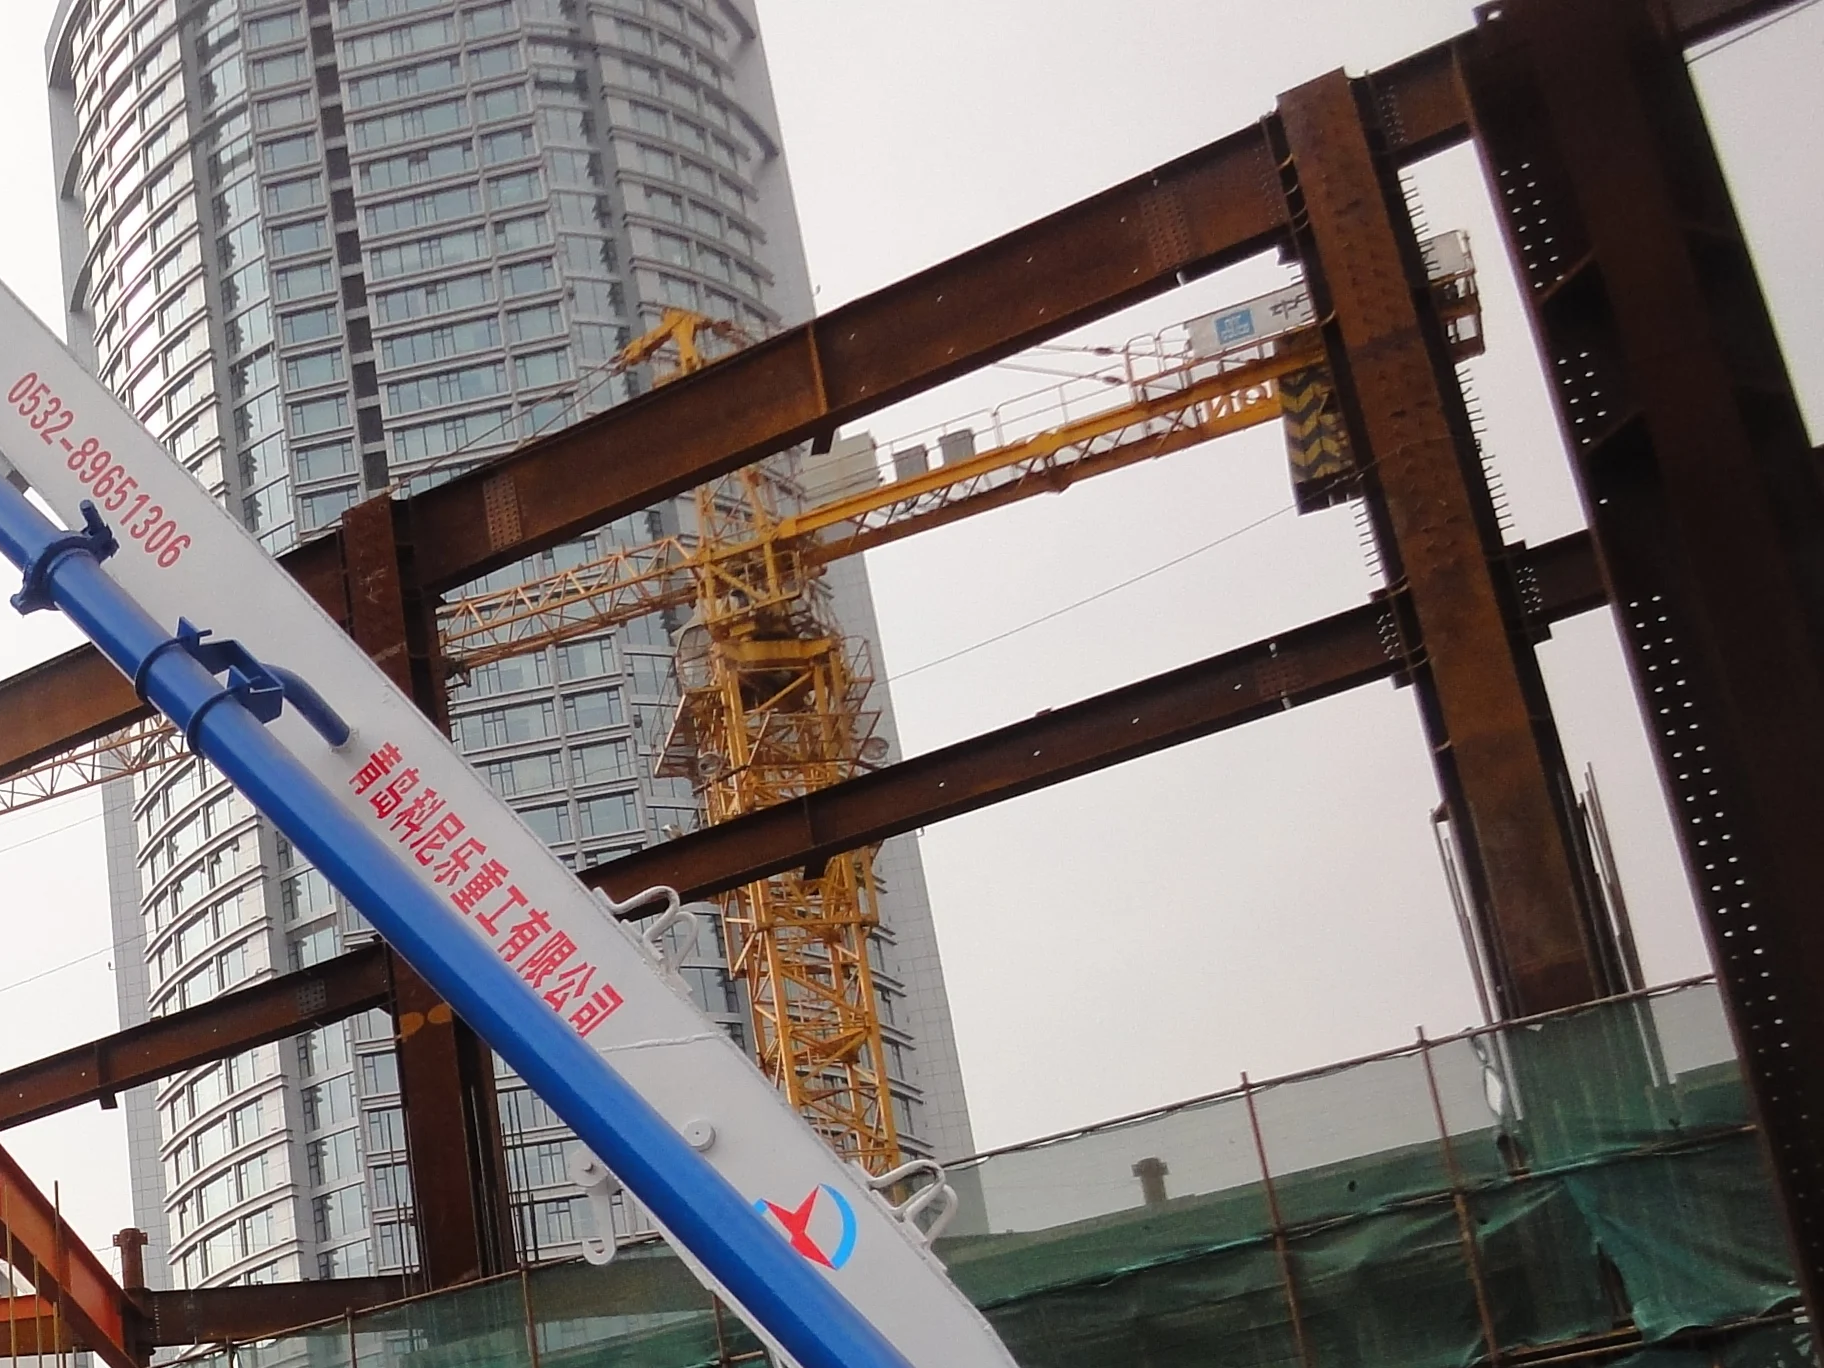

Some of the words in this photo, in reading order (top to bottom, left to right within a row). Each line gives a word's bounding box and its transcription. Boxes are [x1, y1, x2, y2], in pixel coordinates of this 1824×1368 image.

[7, 371, 192, 568] 0532-89651306
[347, 741, 625, 1038] 青岛科尼乐重工有限公司
